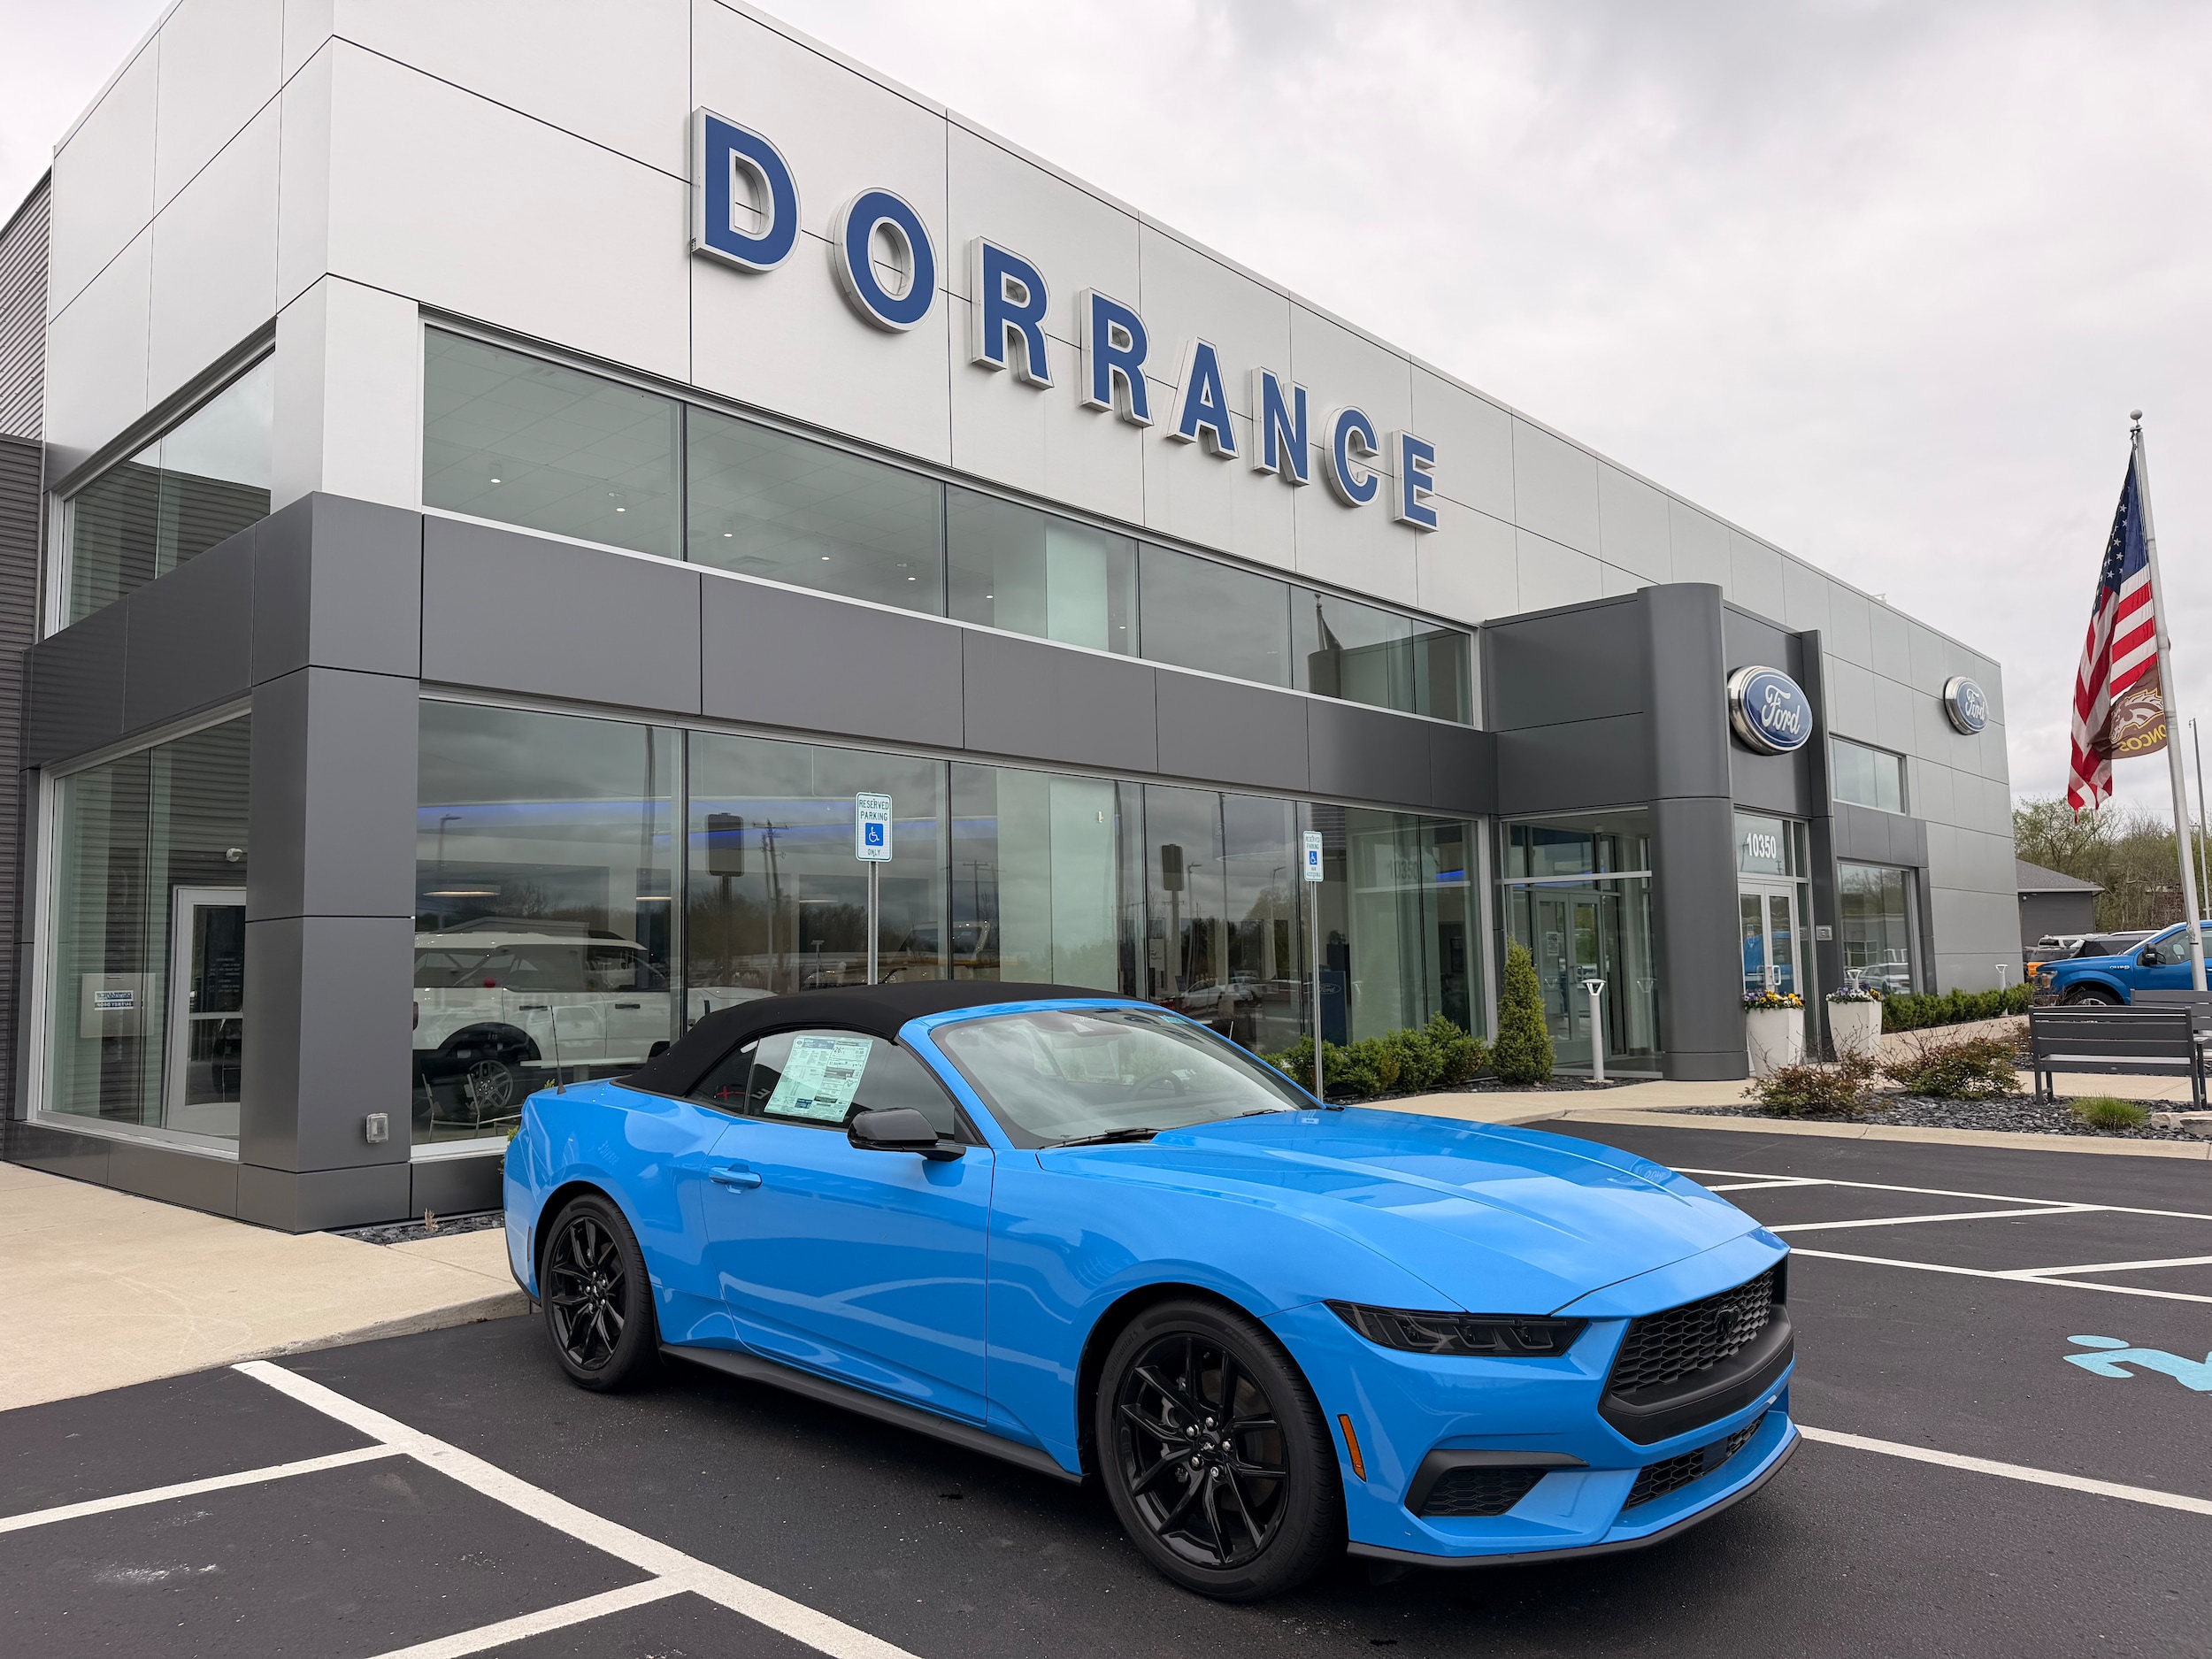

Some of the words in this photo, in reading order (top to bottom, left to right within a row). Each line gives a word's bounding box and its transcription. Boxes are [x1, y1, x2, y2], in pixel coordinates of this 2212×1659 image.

[692, 106, 1440, 533] DORRANCE
[1762, 685, 1801, 734] Ford
[1965, 688, 1985, 721] Ford
[859, 799, 889, 810] RESERVED
[861, 811, 887, 821] PARKING
[1747, 833, 1776, 858] 10350
